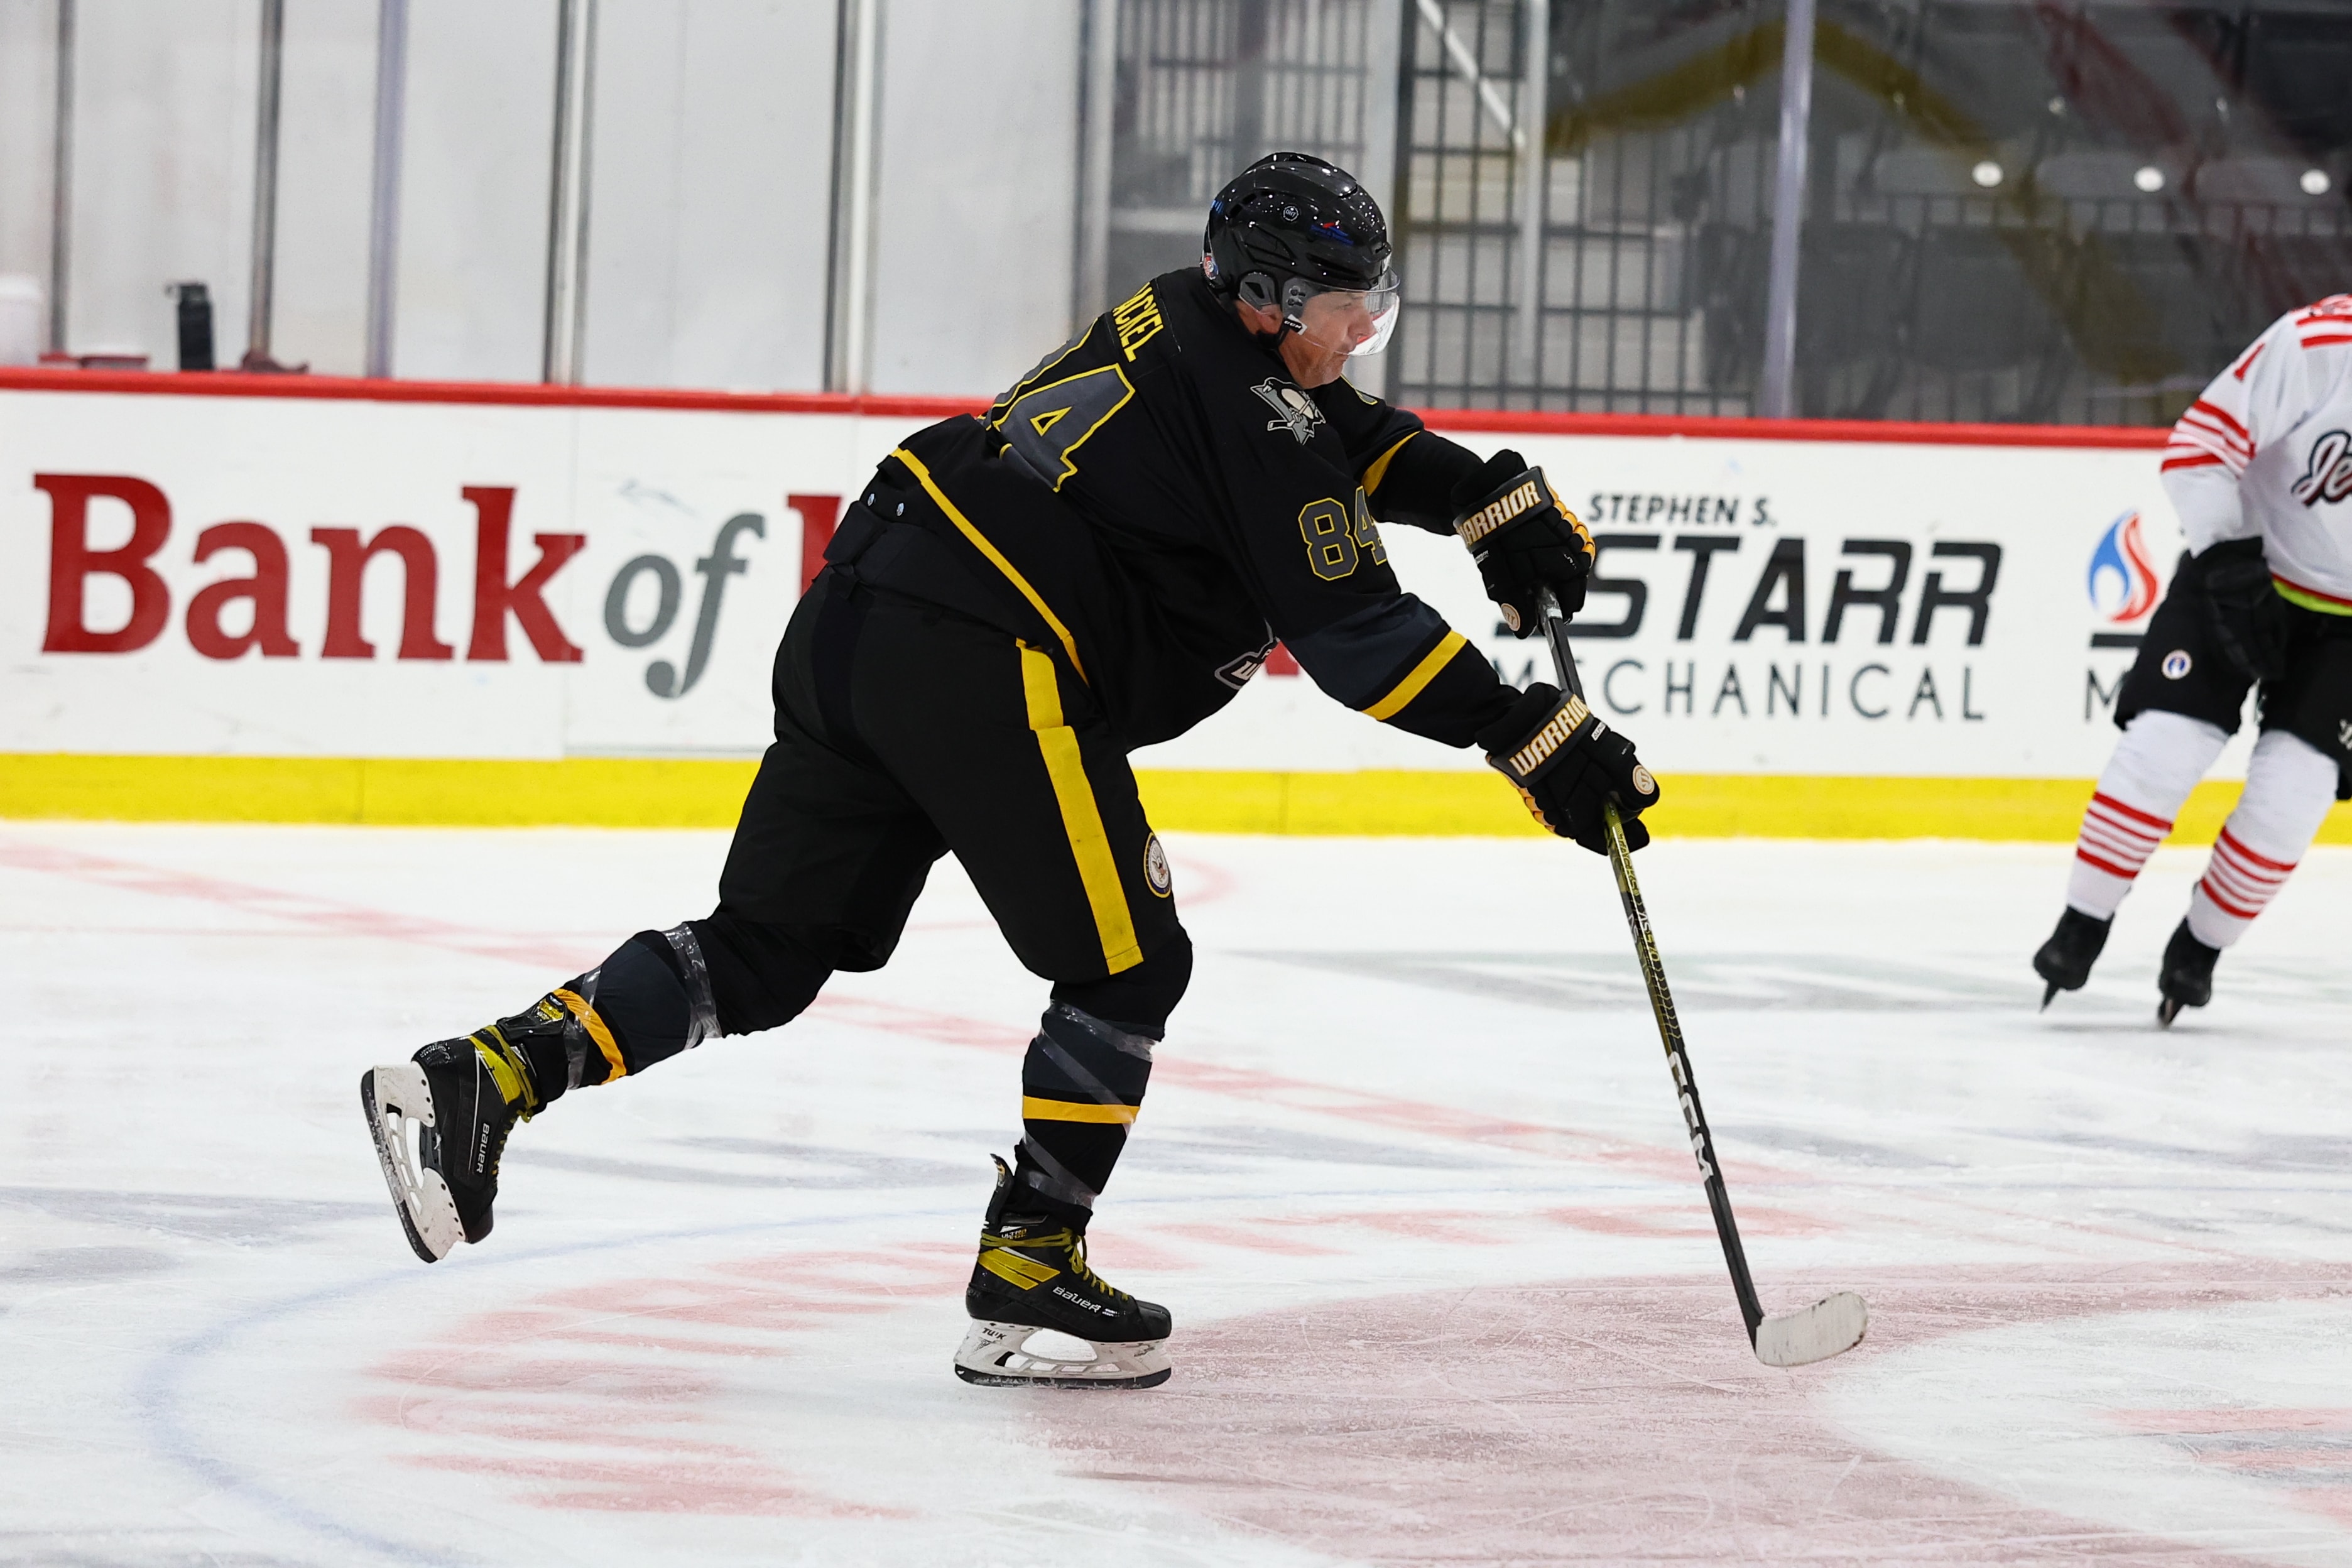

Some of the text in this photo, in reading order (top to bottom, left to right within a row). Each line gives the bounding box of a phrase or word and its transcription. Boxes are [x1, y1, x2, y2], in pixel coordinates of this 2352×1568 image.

[1113, 281, 1164, 362] ACKEL
[1298, 485, 1387, 581] 84
[1588, 493, 1778, 528] STEPHEN S.
[33, 472, 587, 665] Bank
[604, 512, 766, 699] of
[1494, 533, 2003, 646] STARR
[1491, 657, 1985, 721] MCHANICAL
[1509, 694, 1591, 776] WARRIO
